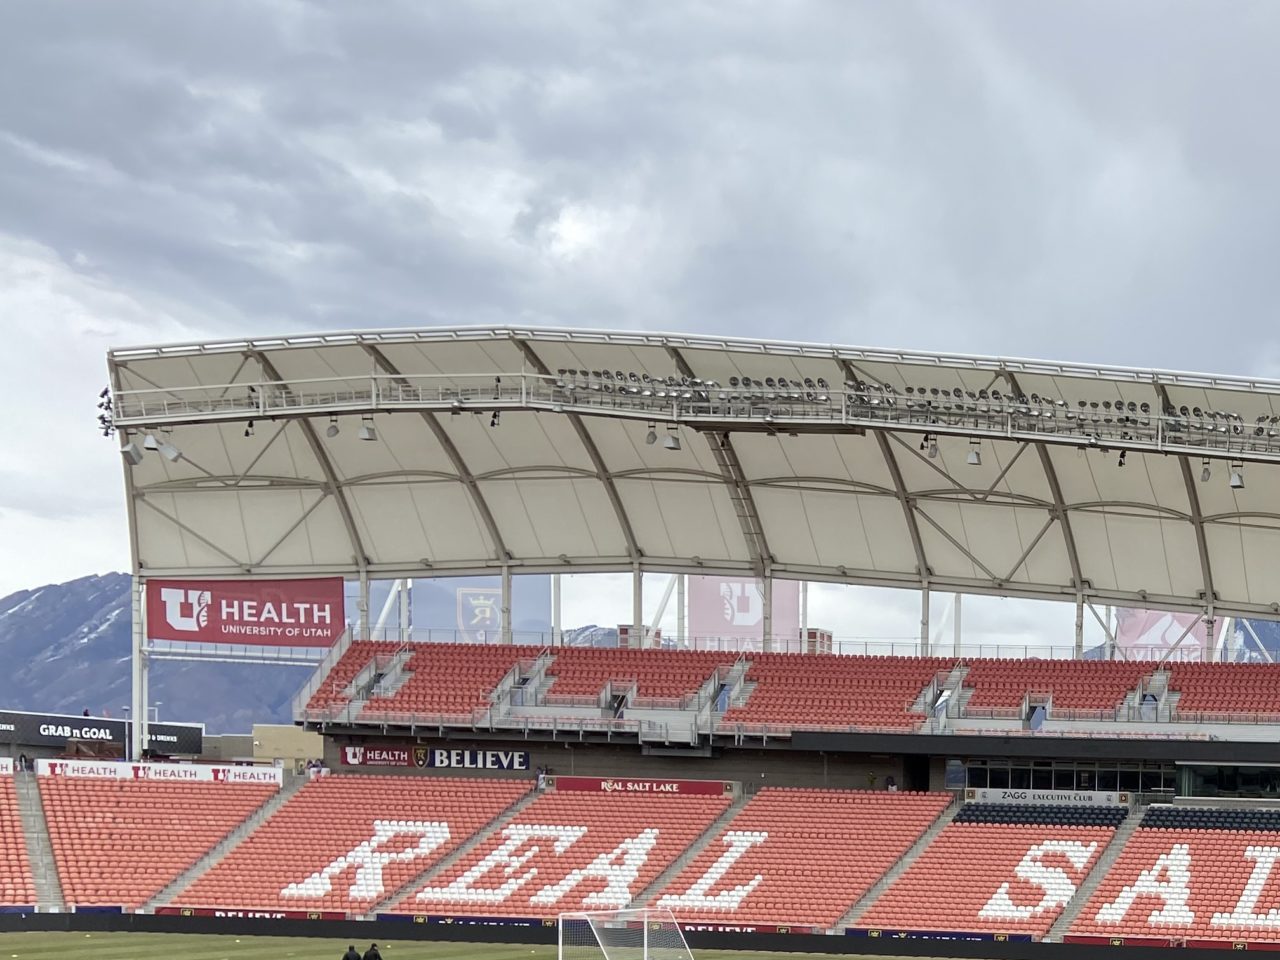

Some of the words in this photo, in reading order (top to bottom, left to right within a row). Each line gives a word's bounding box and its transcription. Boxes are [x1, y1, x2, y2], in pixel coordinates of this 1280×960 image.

[221, 600, 331, 624] HEALTH
[221, 624, 284, 637] UNIVERSITY
[285, 627, 300, 637] OF
[303, 628, 331, 637] UTAH
[40, 724, 71, 737] GRAB
[72, 728, 81, 738] n
[81, 727, 113, 740] GOAL
[366, 750, 408, 761] HEALTH
[434, 749, 526, 769] BELIEVE
[72, 766, 117, 776] HEALTH
[154, 769, 197, 778] HEALTH
[233, 771, 276, 781] HEALTH
[627, 782, 651, 791] SALT
[653, 783, 679, 792] LAKE
[1002, 792, 1027, 800] ZAGG
[280, 818, 769, 913] REAL
